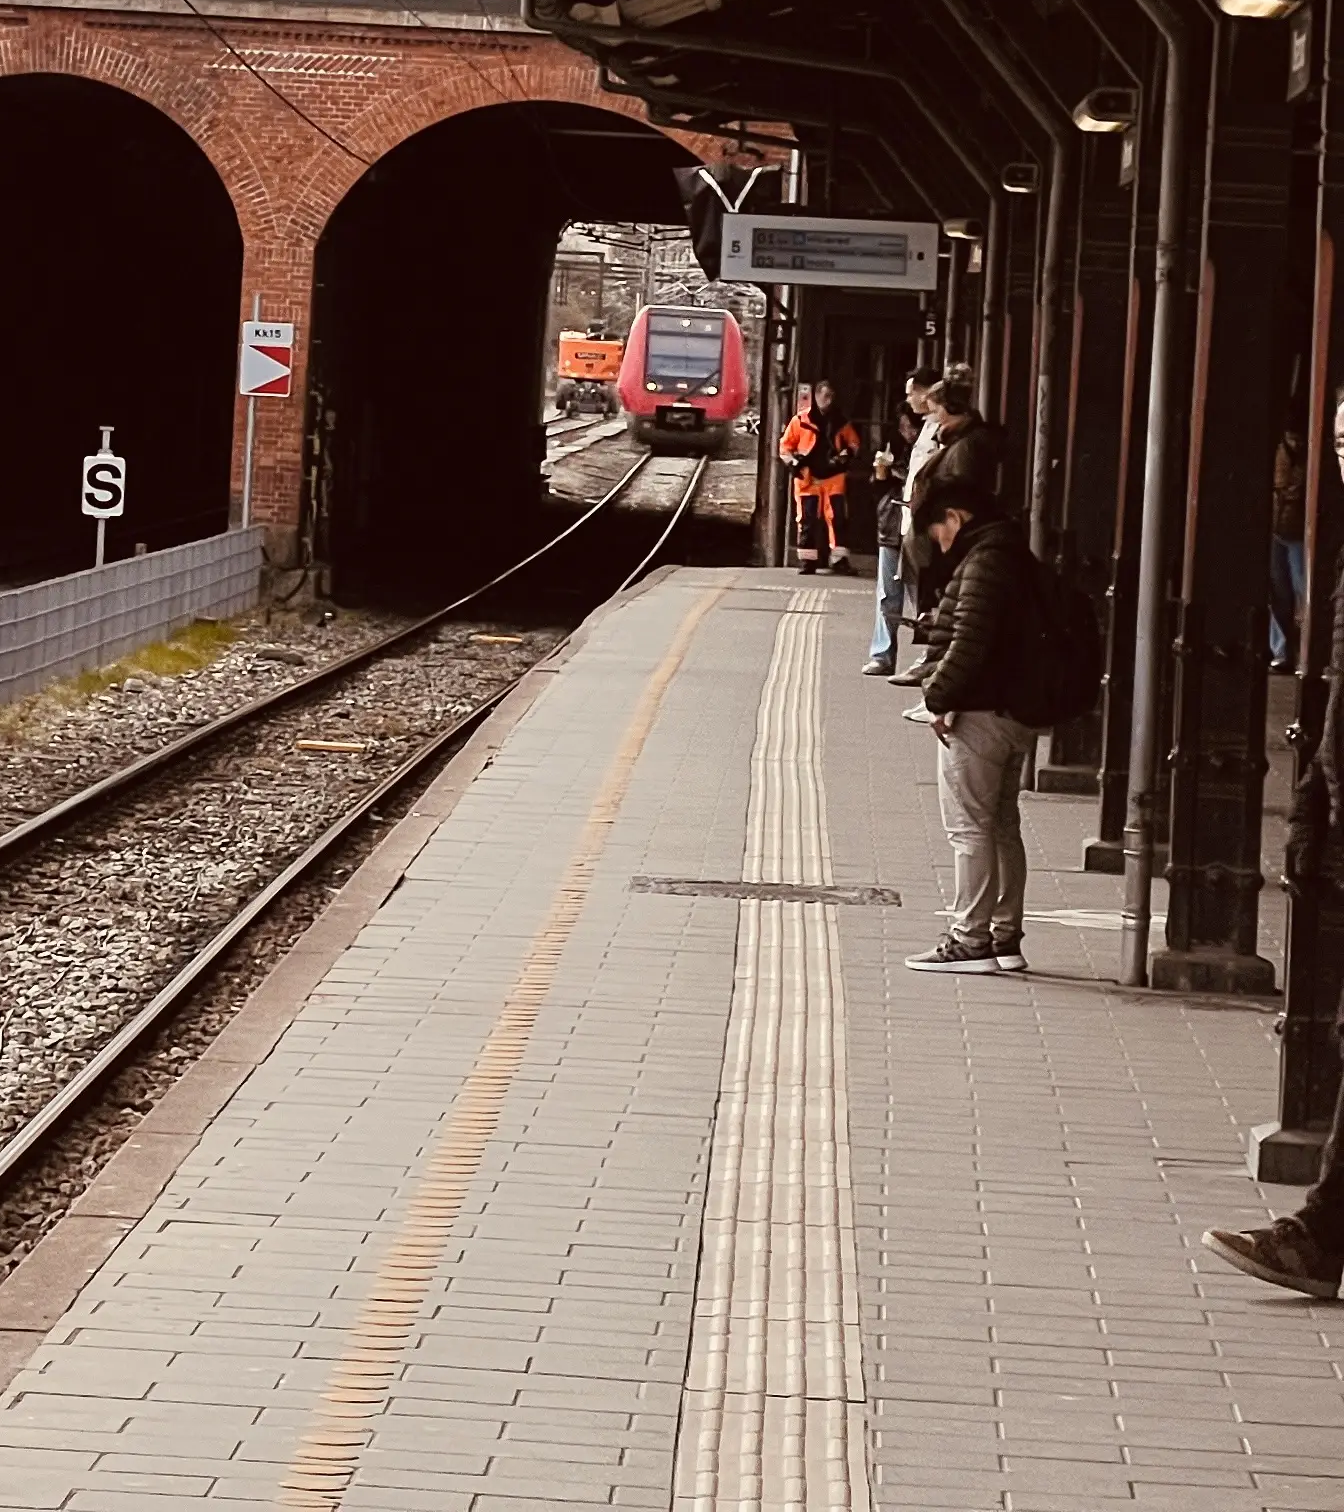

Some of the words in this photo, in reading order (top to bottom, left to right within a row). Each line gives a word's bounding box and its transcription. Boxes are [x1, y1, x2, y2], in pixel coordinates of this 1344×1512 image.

[731, 240, 741, 253] 5
[925, 321, 936, 336] 5
[85, 463, 122, 510] S
